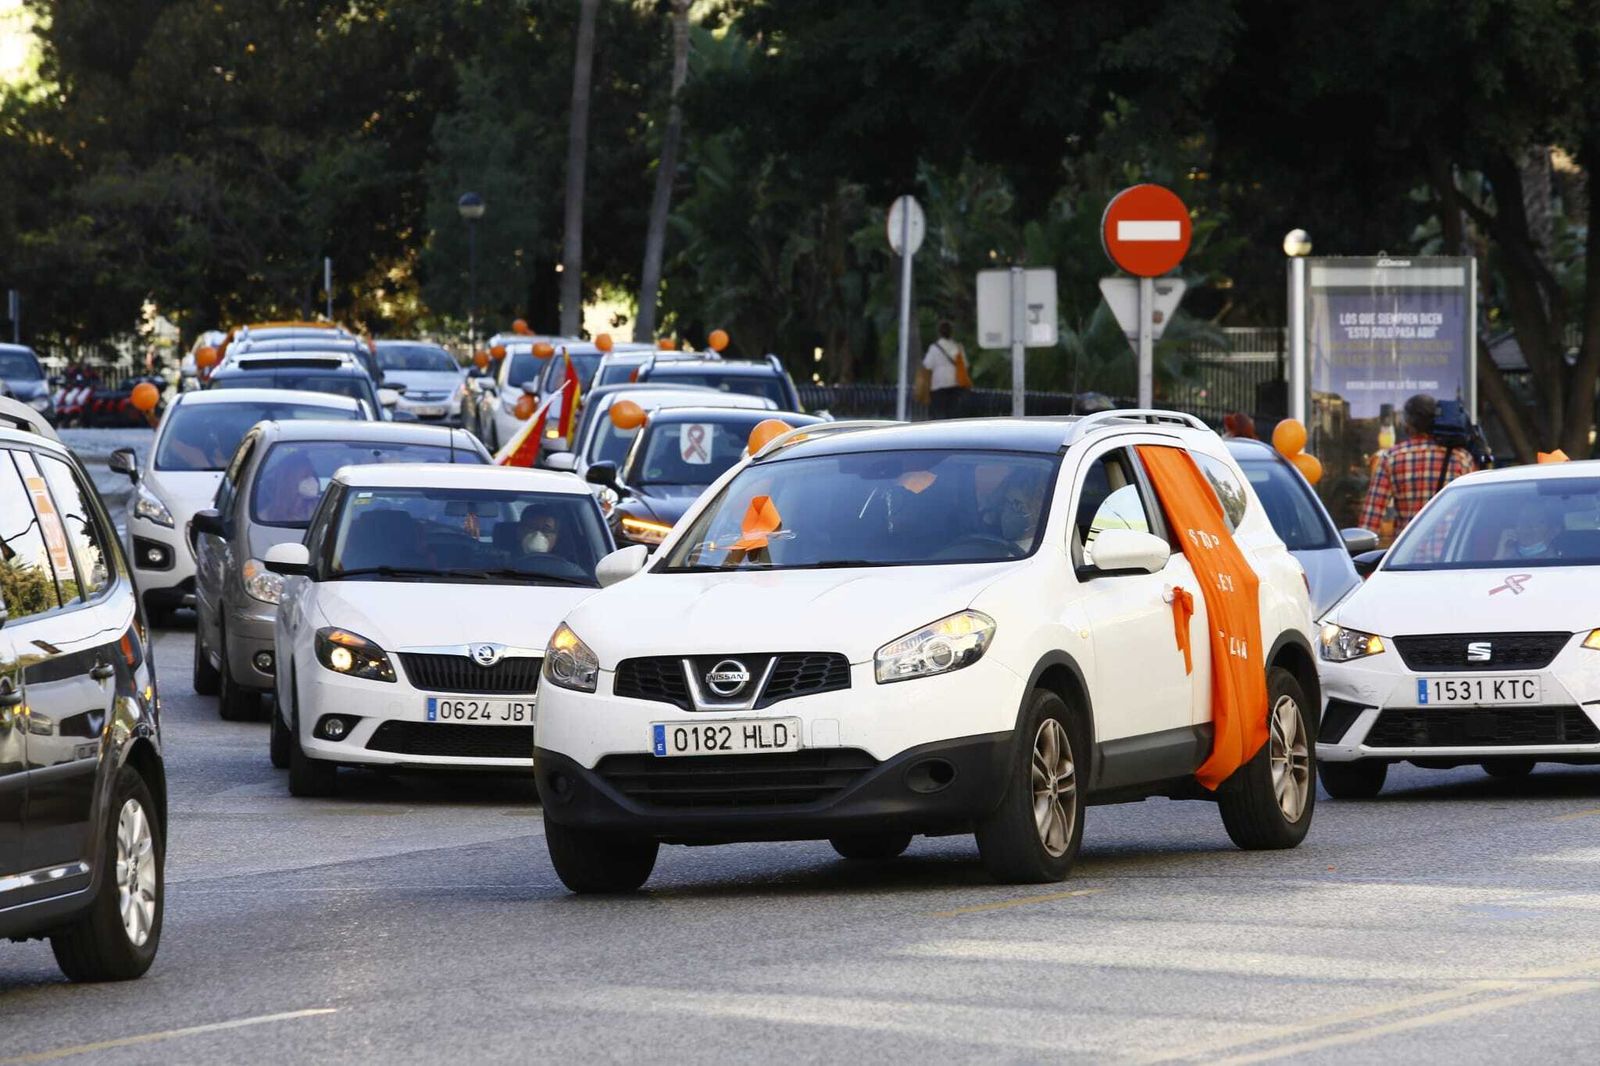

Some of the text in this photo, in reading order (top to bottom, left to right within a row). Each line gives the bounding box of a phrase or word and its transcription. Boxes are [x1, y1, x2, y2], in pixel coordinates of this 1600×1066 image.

[1340, 313, 1357, 325] LOS
[1359, 313, 1376, 325] QUE
[1420, 313, 1443, 325] DICEN
[708, 673, 745, 681] NISSAN
[1434, 680, 1534, 700] 1531 KTC
[440, 701, 535, 721] 0624 JBT
[674, 726, 732, 751] 0182
[743, 723, 788, 749] HLD
